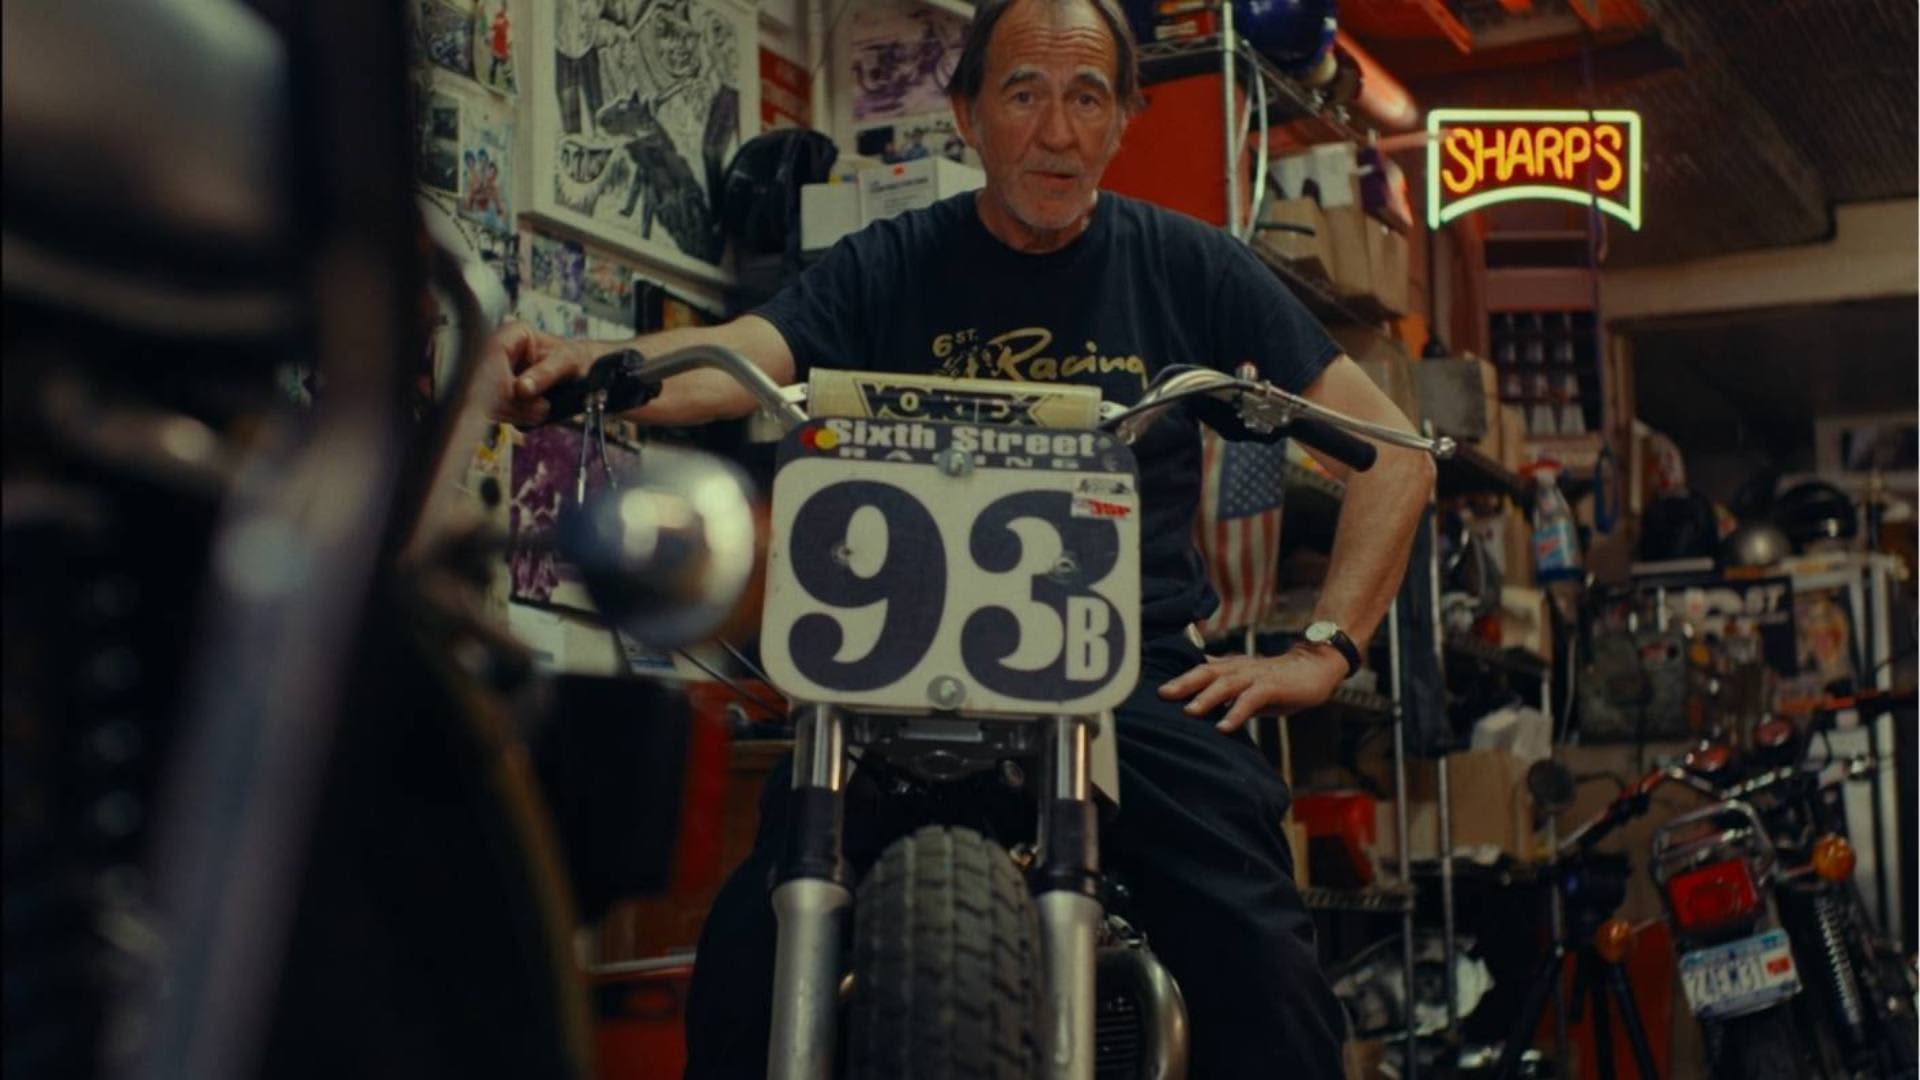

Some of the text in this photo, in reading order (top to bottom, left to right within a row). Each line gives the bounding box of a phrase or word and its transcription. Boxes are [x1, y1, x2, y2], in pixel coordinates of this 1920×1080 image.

[986, 326, 1149, 391] Racing
[825, 417, 1096, 457] Sixth Street
[839, 447, 1079, 469] RAING
